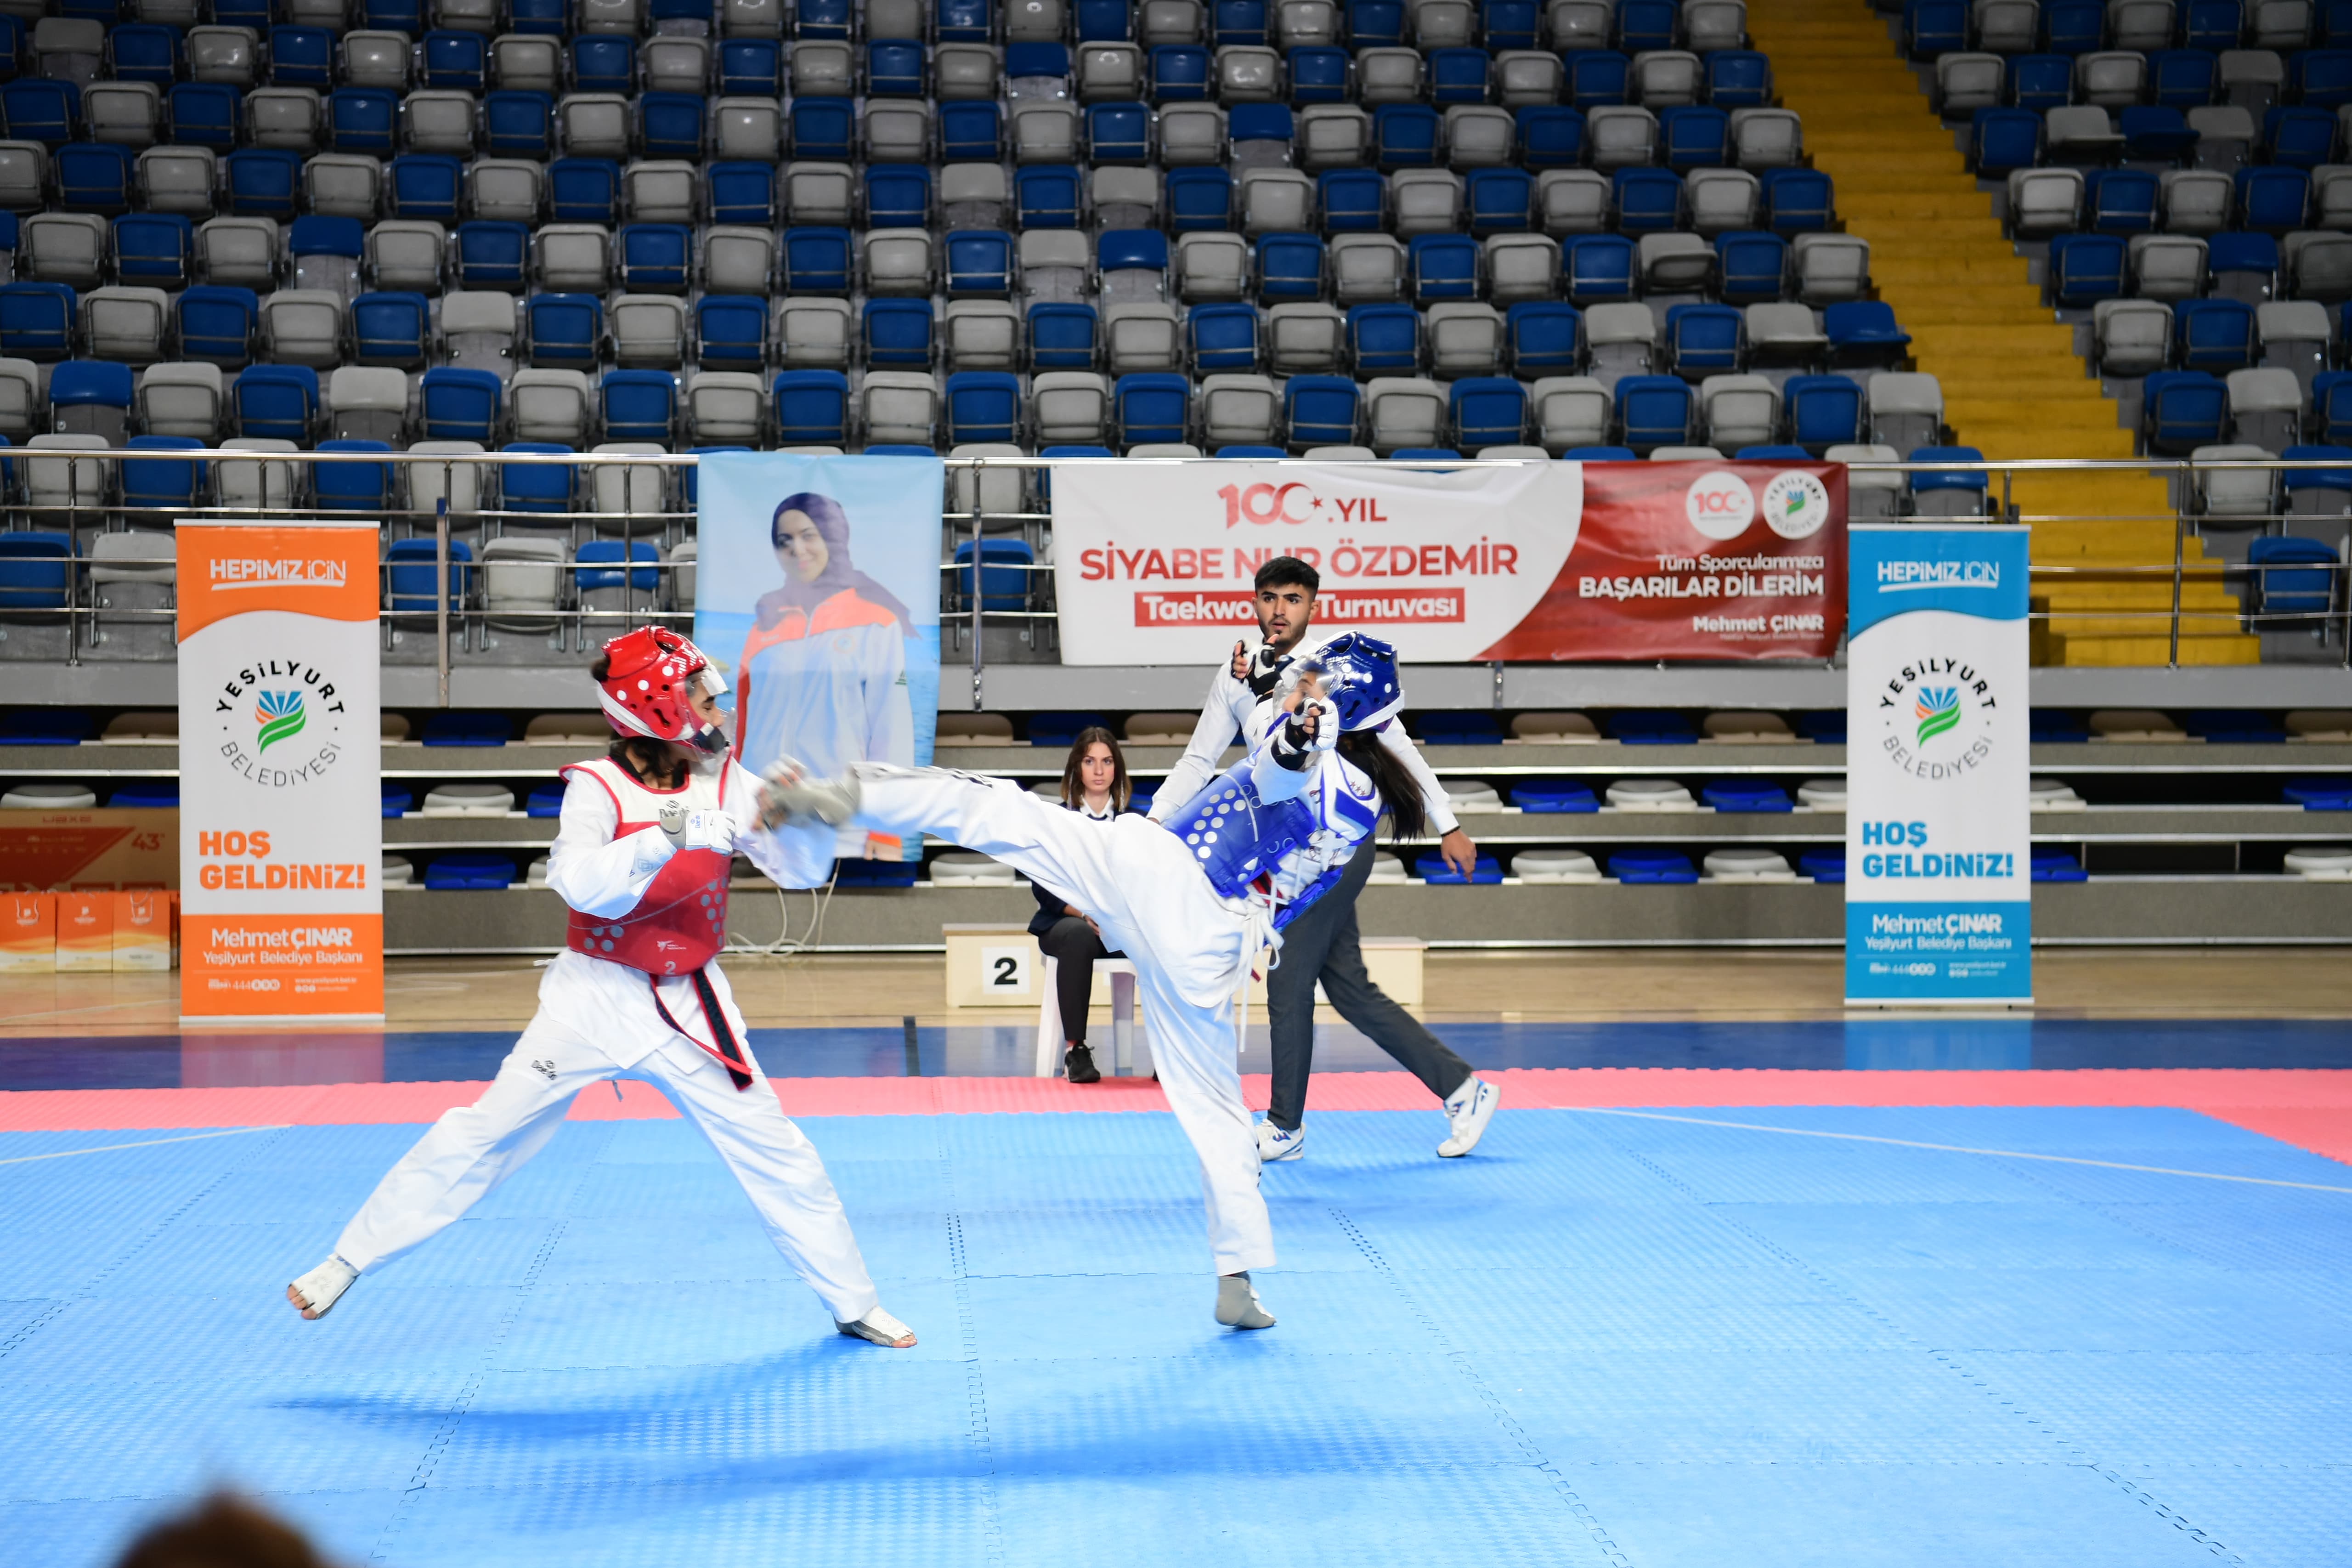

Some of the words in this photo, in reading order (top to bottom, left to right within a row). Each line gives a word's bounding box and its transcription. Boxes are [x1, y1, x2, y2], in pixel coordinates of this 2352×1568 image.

[1080, 541, 1223, 580] SİYABE
[1330, 535, 1518, 577] ÖZDEMİR
[1656, 554, 1696, 572] Tüm
[1579, 576, 1719, 602] BAŞARILAR
[1724, 570, 1824, 597] DİLERİM
[1142, 594, 1258, 621] Taekwo
[1317, 593, 1457, 619] Turnuvası
[1693, 615, 1766, 632] Mehmet
[1770, 614, 1824, 634] ÇINAR
[199, 830, 271, 859] HOŞ
[1862, 821, 1928, 848] HOŞ
[1872, 913, 1944, 934] Mehmet
[1945, 913, 2002, 936] ÇINAR
[211, 928, 288, 947] Mehmet
[291, 928, 352, 950] ÇINAR
[260, 951, 312, 966] Belediye
[665, 960, 677, 975] 2
[994, 957, 1018, 985] 2
